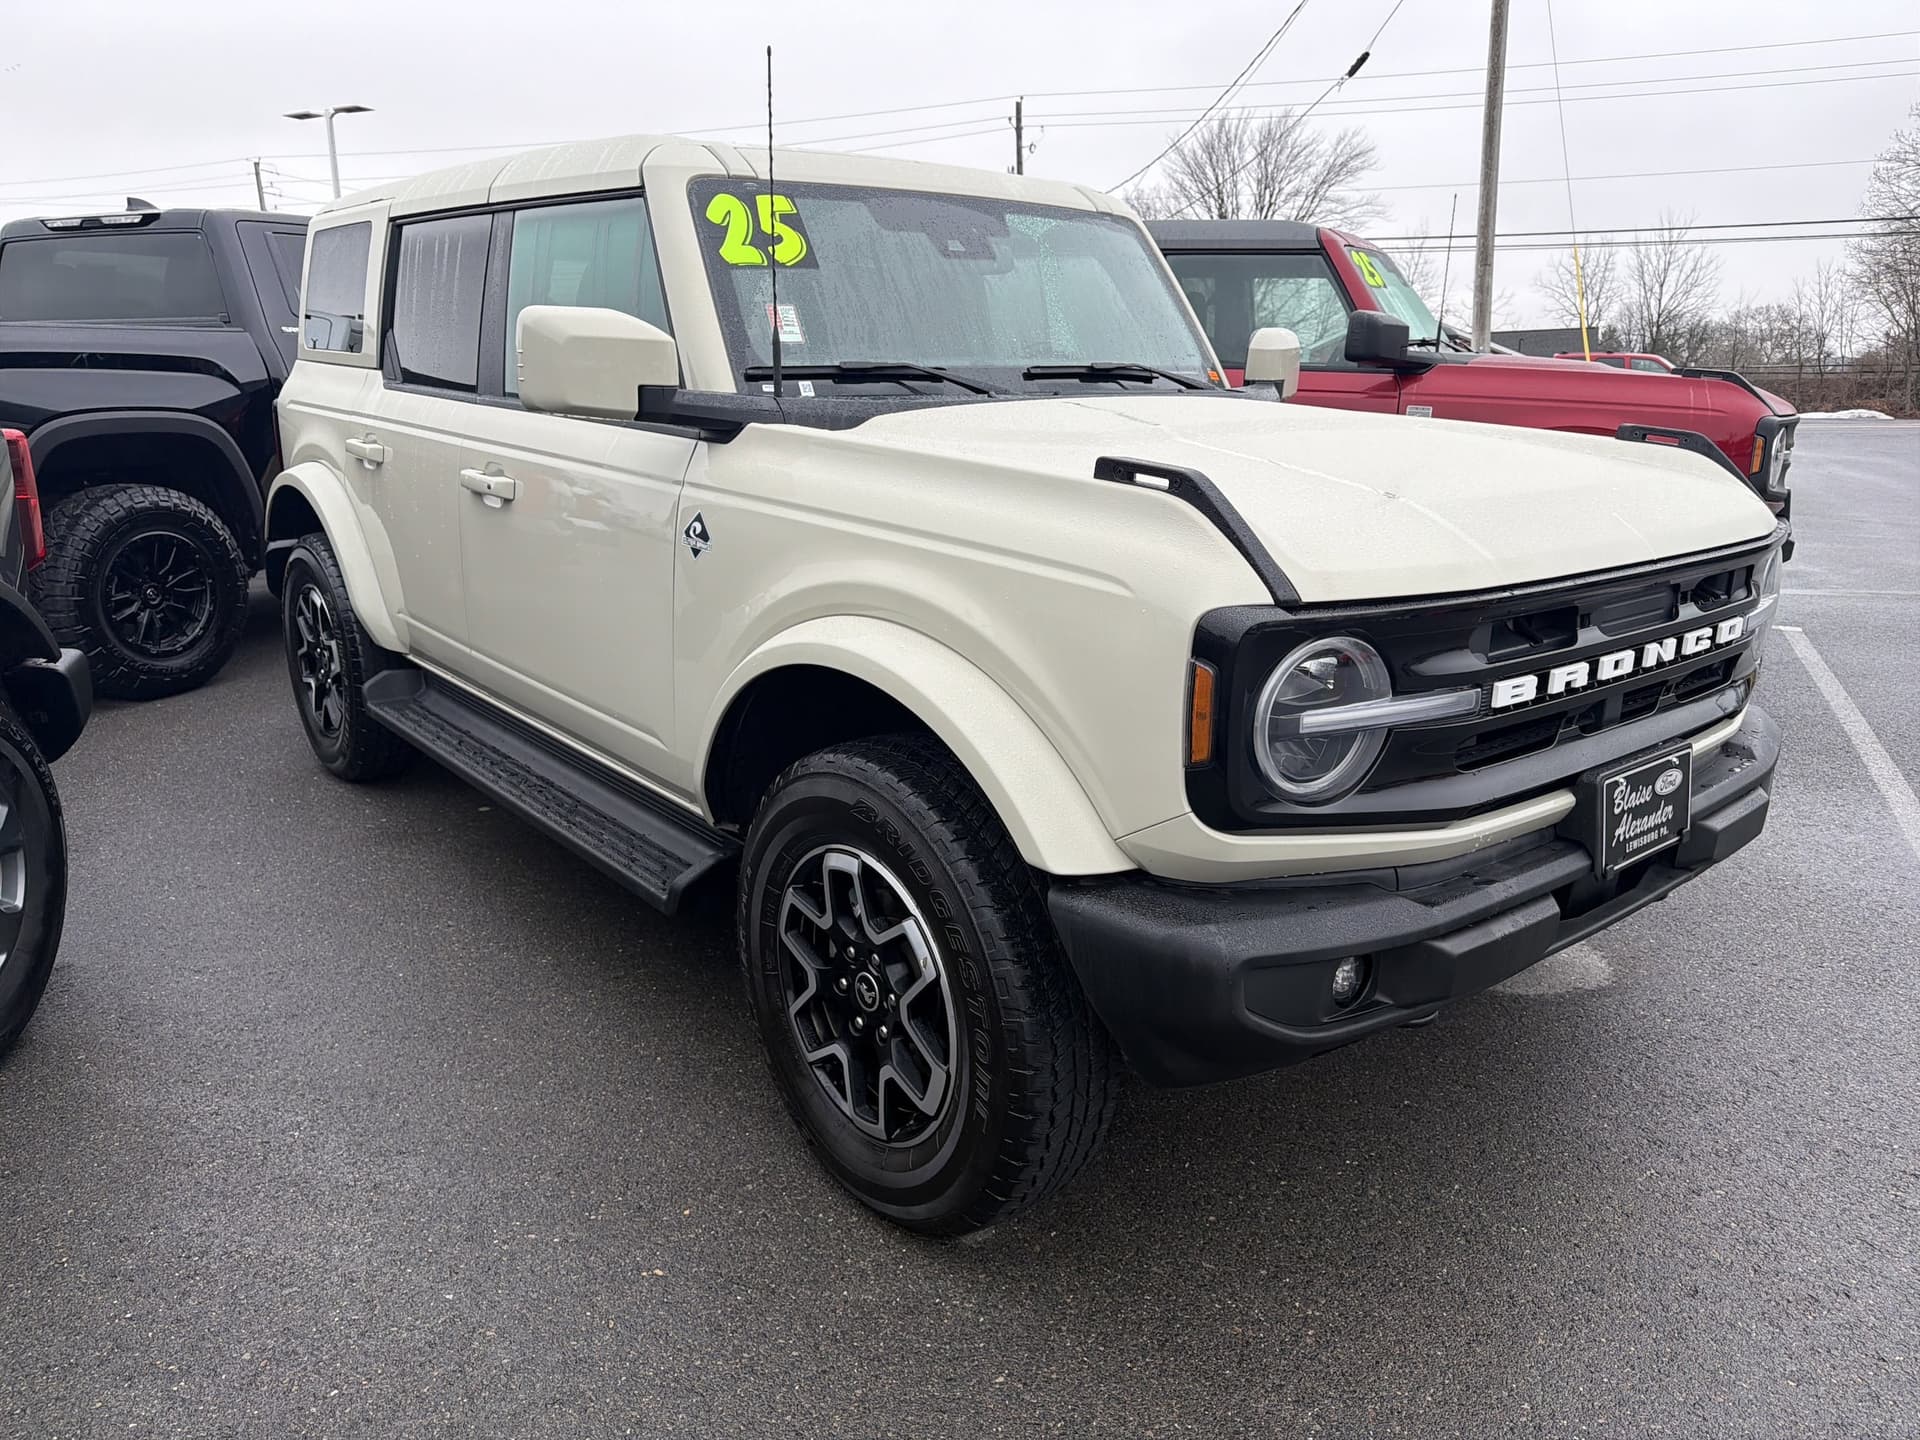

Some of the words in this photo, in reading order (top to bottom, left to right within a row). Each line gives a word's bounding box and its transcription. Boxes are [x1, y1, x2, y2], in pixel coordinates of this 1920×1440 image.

[706, 193, 807, 266] 25
[1351, 250, 1386, 288] 25
[1491, 616, 1744, 708] BRONCO
[1613, 784, 1653, 815] Blaise
[1612, 800, 1674, 847] Alexander
[1626, 830, 1659, 853] LEWISBURG
[851, 799, 992, 1134] BRIDGESTONE
